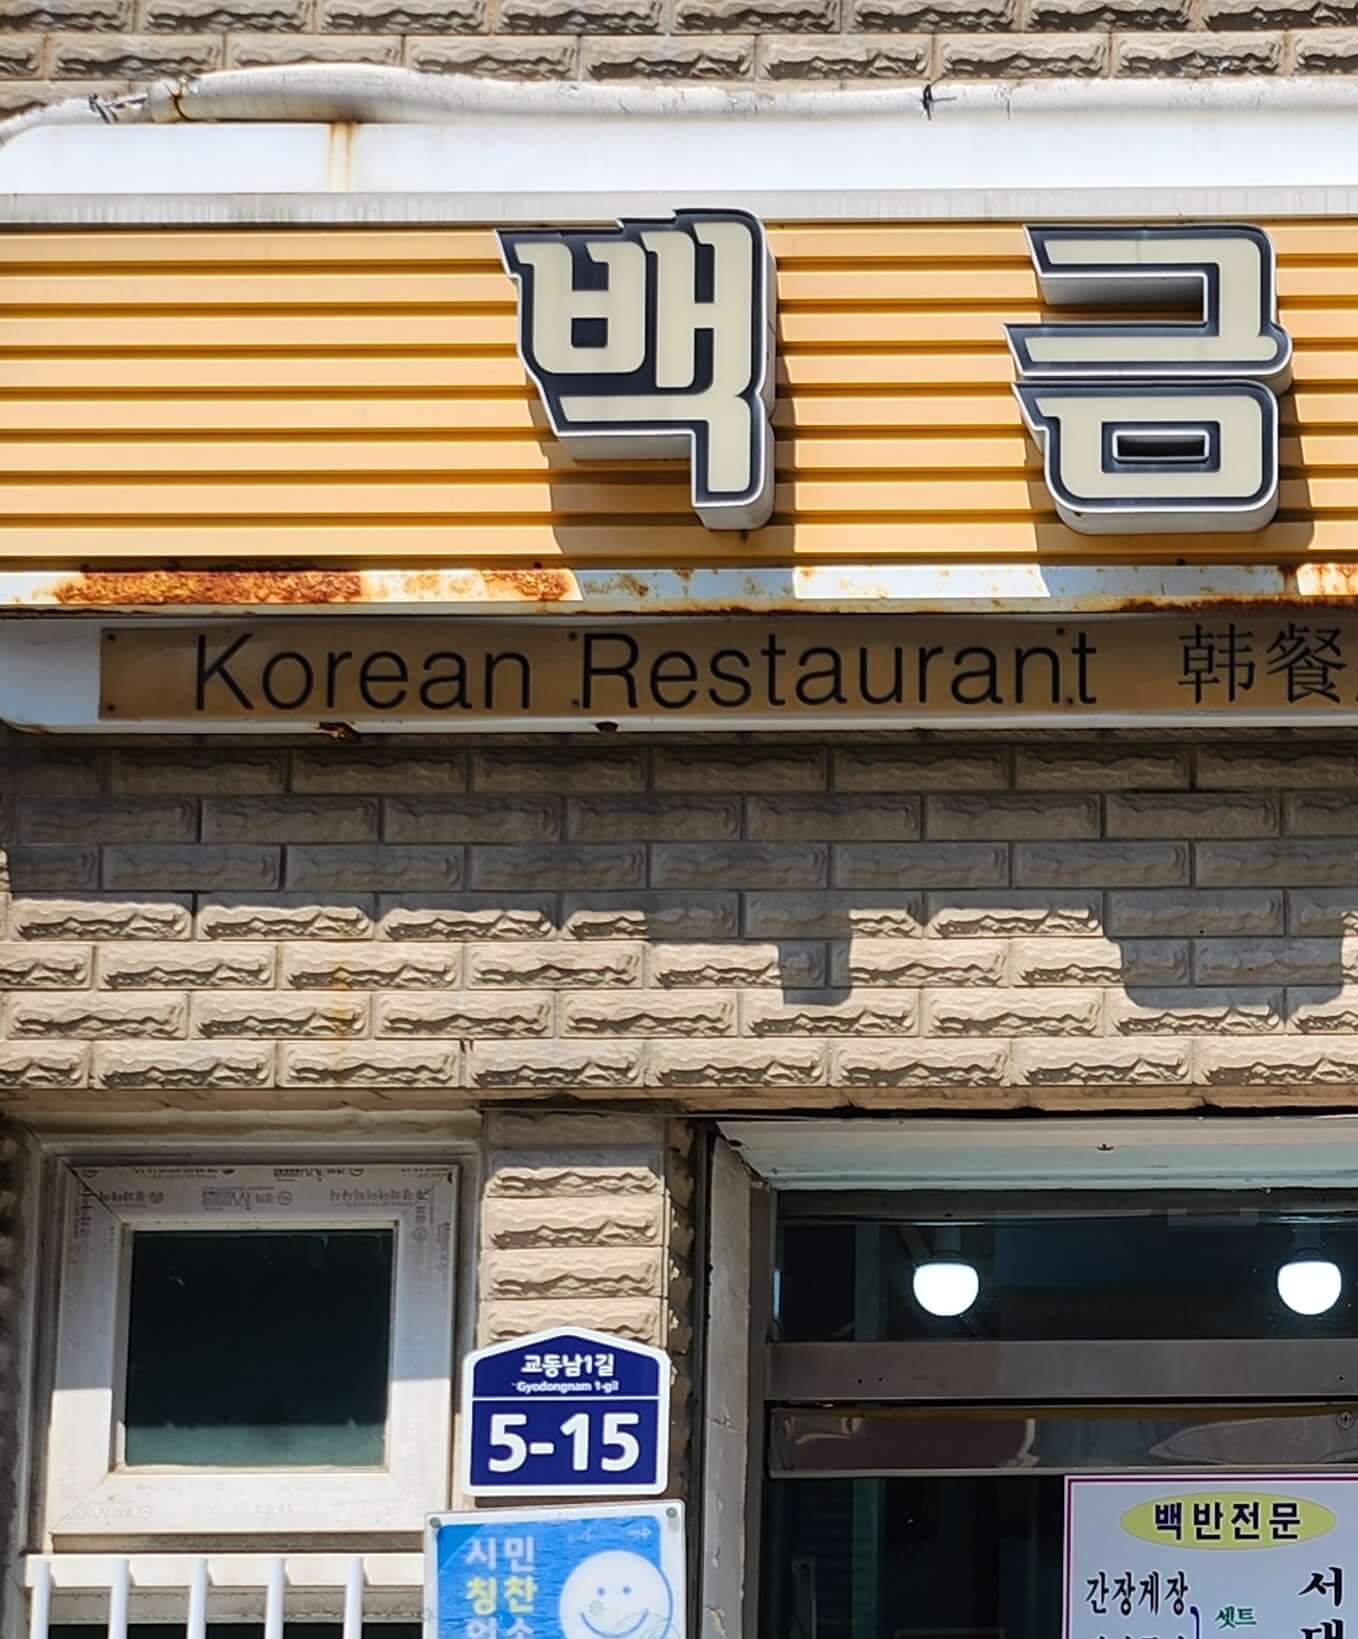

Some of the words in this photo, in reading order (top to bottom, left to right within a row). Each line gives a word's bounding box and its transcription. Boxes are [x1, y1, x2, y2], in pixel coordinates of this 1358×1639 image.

[196, 631, 531, 711] Korean
[581, 630, 1097, 710] Restaurant
[516, 1381, 592, 1394] Gyodongnam
[488, 1413, 640, 1473] 5-15
[1154, 1502, 1301, 1540] 백반전문
[465, 1536, 536, 1572] 시민
[465, 1575, 538, 1616] 칭찬
[1085, 1571, 1188, 1616] 간장게장
